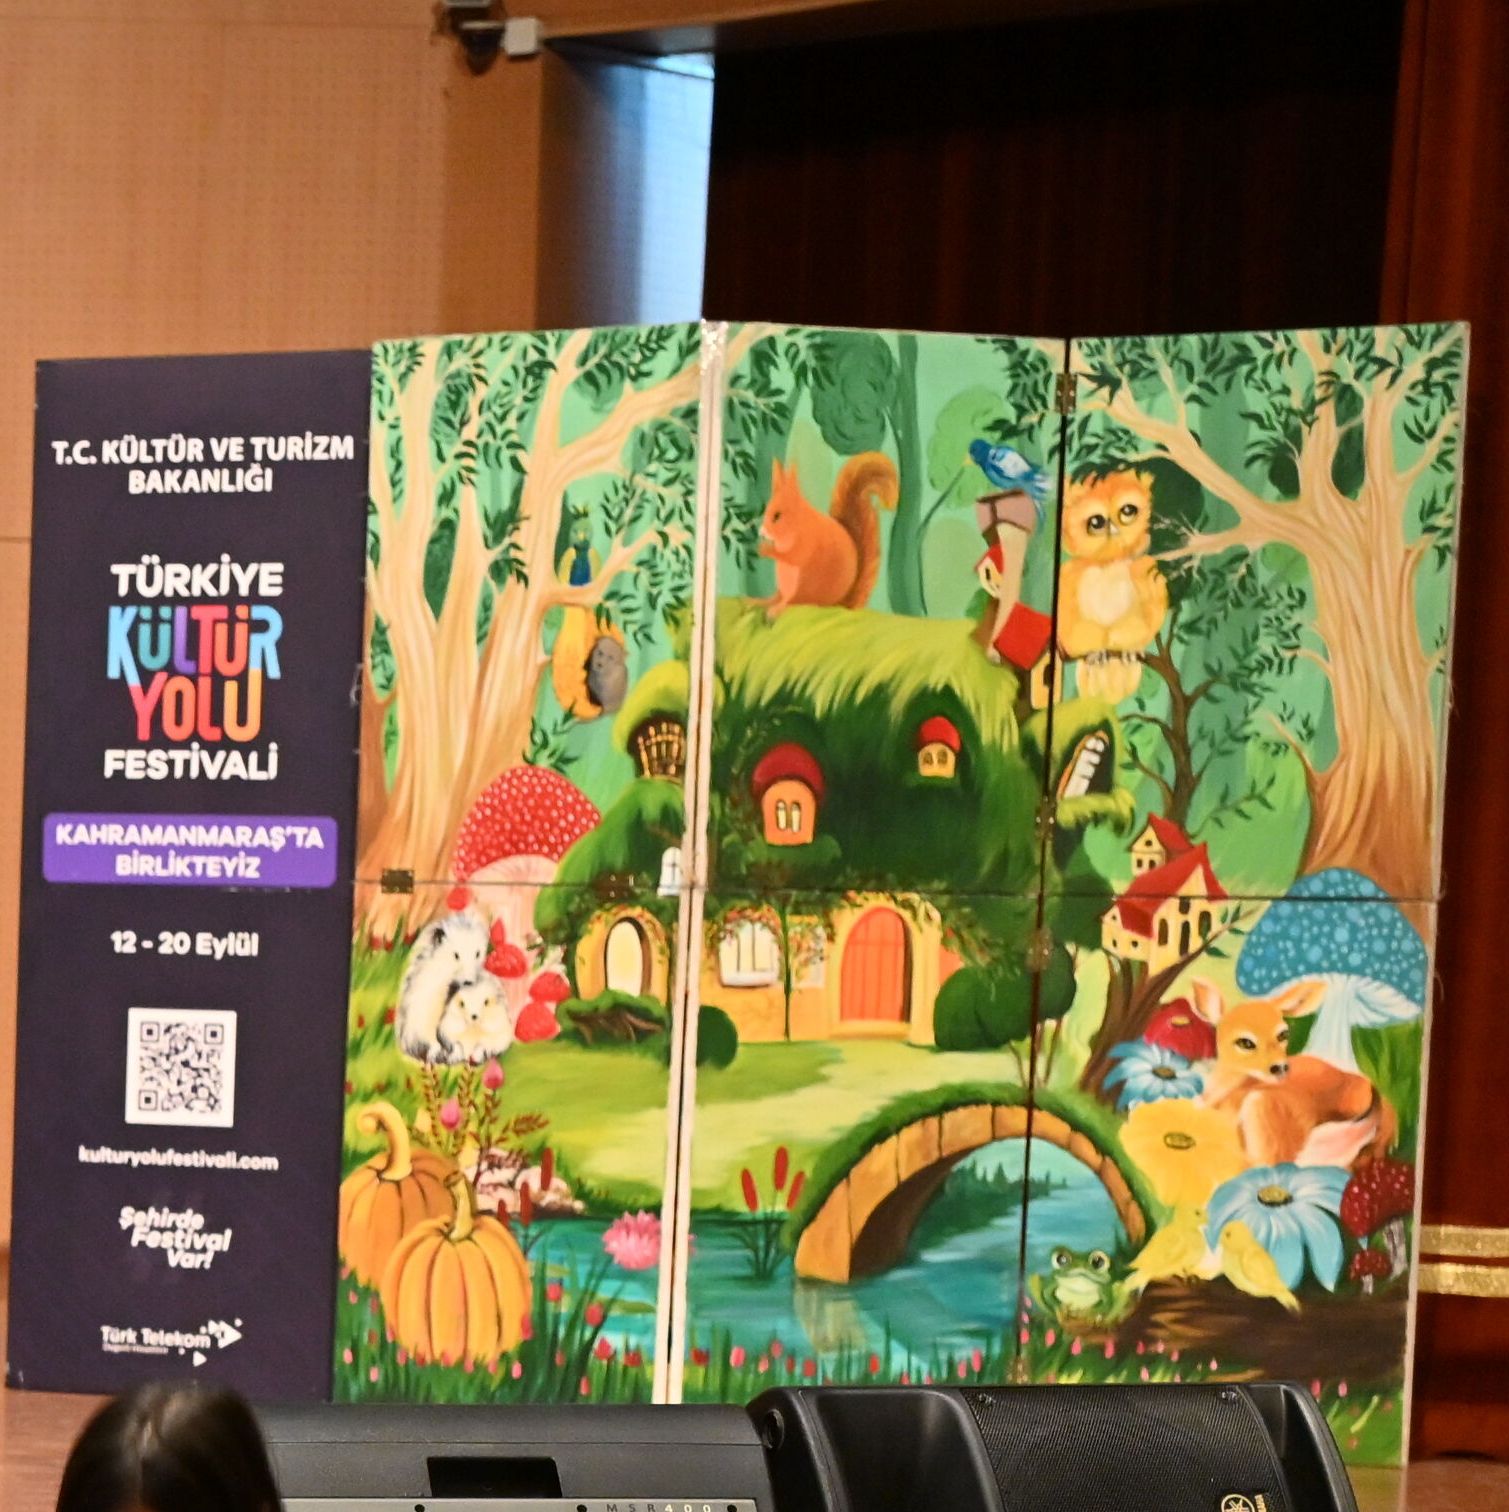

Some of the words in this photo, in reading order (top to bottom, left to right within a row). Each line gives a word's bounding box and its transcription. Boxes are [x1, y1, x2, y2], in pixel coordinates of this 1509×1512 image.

[51, 439, 98, 466] T.C.
[101, 433, 205, 465] KÜLTÜR
[209, 436, 245, 462] VE
[249, 430, 355, 462] TURİZM
[127, 463, 274, 495] BAKANLIĞI
[109, 553, 285, 598] TÜRKİYE
[106, 604, 283, 681] KÜLTÜR
[128, 669, 263, 743] YOLU
[103, 741, 279, 781] FESTİVALİ
[54, 822, 325, 852] KAHRAMANMARAŞ'TA
[114, 850, 261, 879] BİRLİKTEYİZ
[110, 930, 137, 954] 12
[157, 931, 192, 955] 20
[195, 931, 260, 960] Eylül
[77, 1144, 281, 1171] kulturyolufestivali.com
[118, 1206, 206, 1231] Şehirde
[130, 1226, 233, 1252] Festival
[166, 1247, 216, 1270] Var!
[100, 1325, 138, 1344] Türk
[140, 1326, 212, 1348] Telekom
